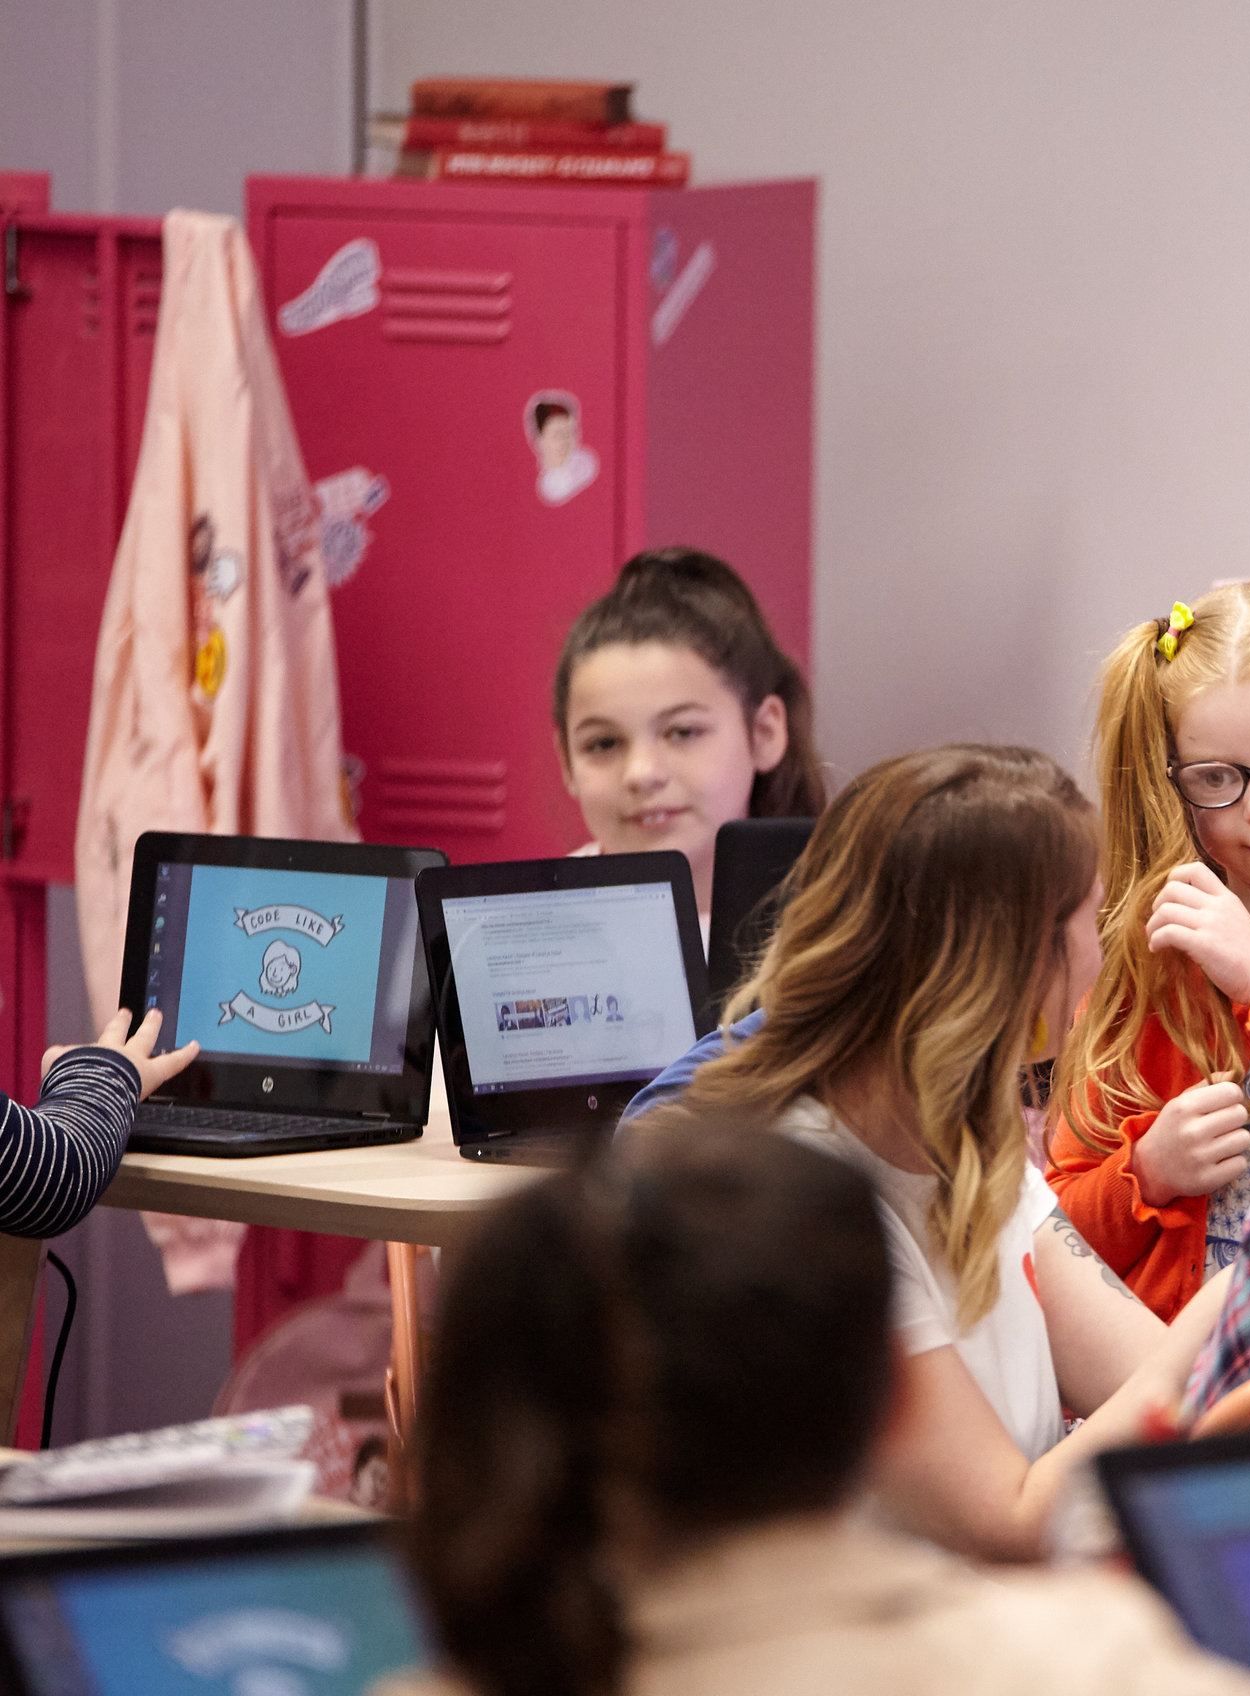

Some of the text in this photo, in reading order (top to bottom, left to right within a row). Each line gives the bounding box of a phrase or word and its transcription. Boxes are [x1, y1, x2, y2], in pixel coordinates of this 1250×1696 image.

[250, 908, 325, 936] CODE LIKE
[246, 1005, 312, 1029] A GIRL
